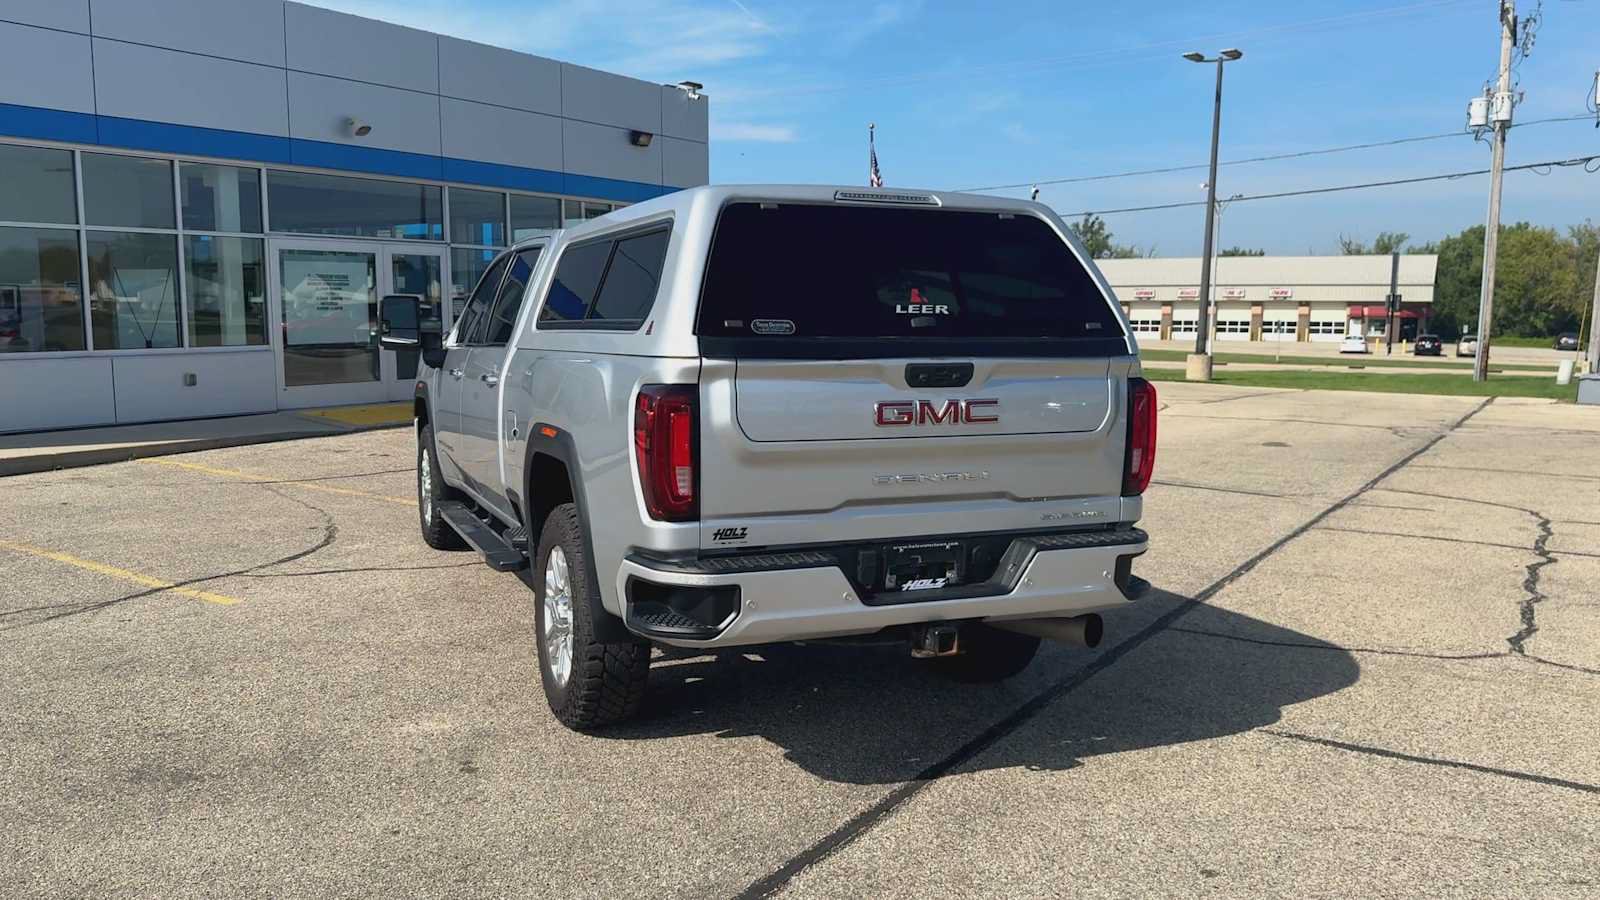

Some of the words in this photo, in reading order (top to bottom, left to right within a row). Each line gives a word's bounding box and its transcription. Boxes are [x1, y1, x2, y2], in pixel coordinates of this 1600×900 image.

[896, 303, 950, 315] LEER
[873, 398, 1000, 428] GMC
[872, 470, 991, 487] DENALI
[713, 527, 748, 541] HOLZ
[901, 578, 946, 592] HOLZ
